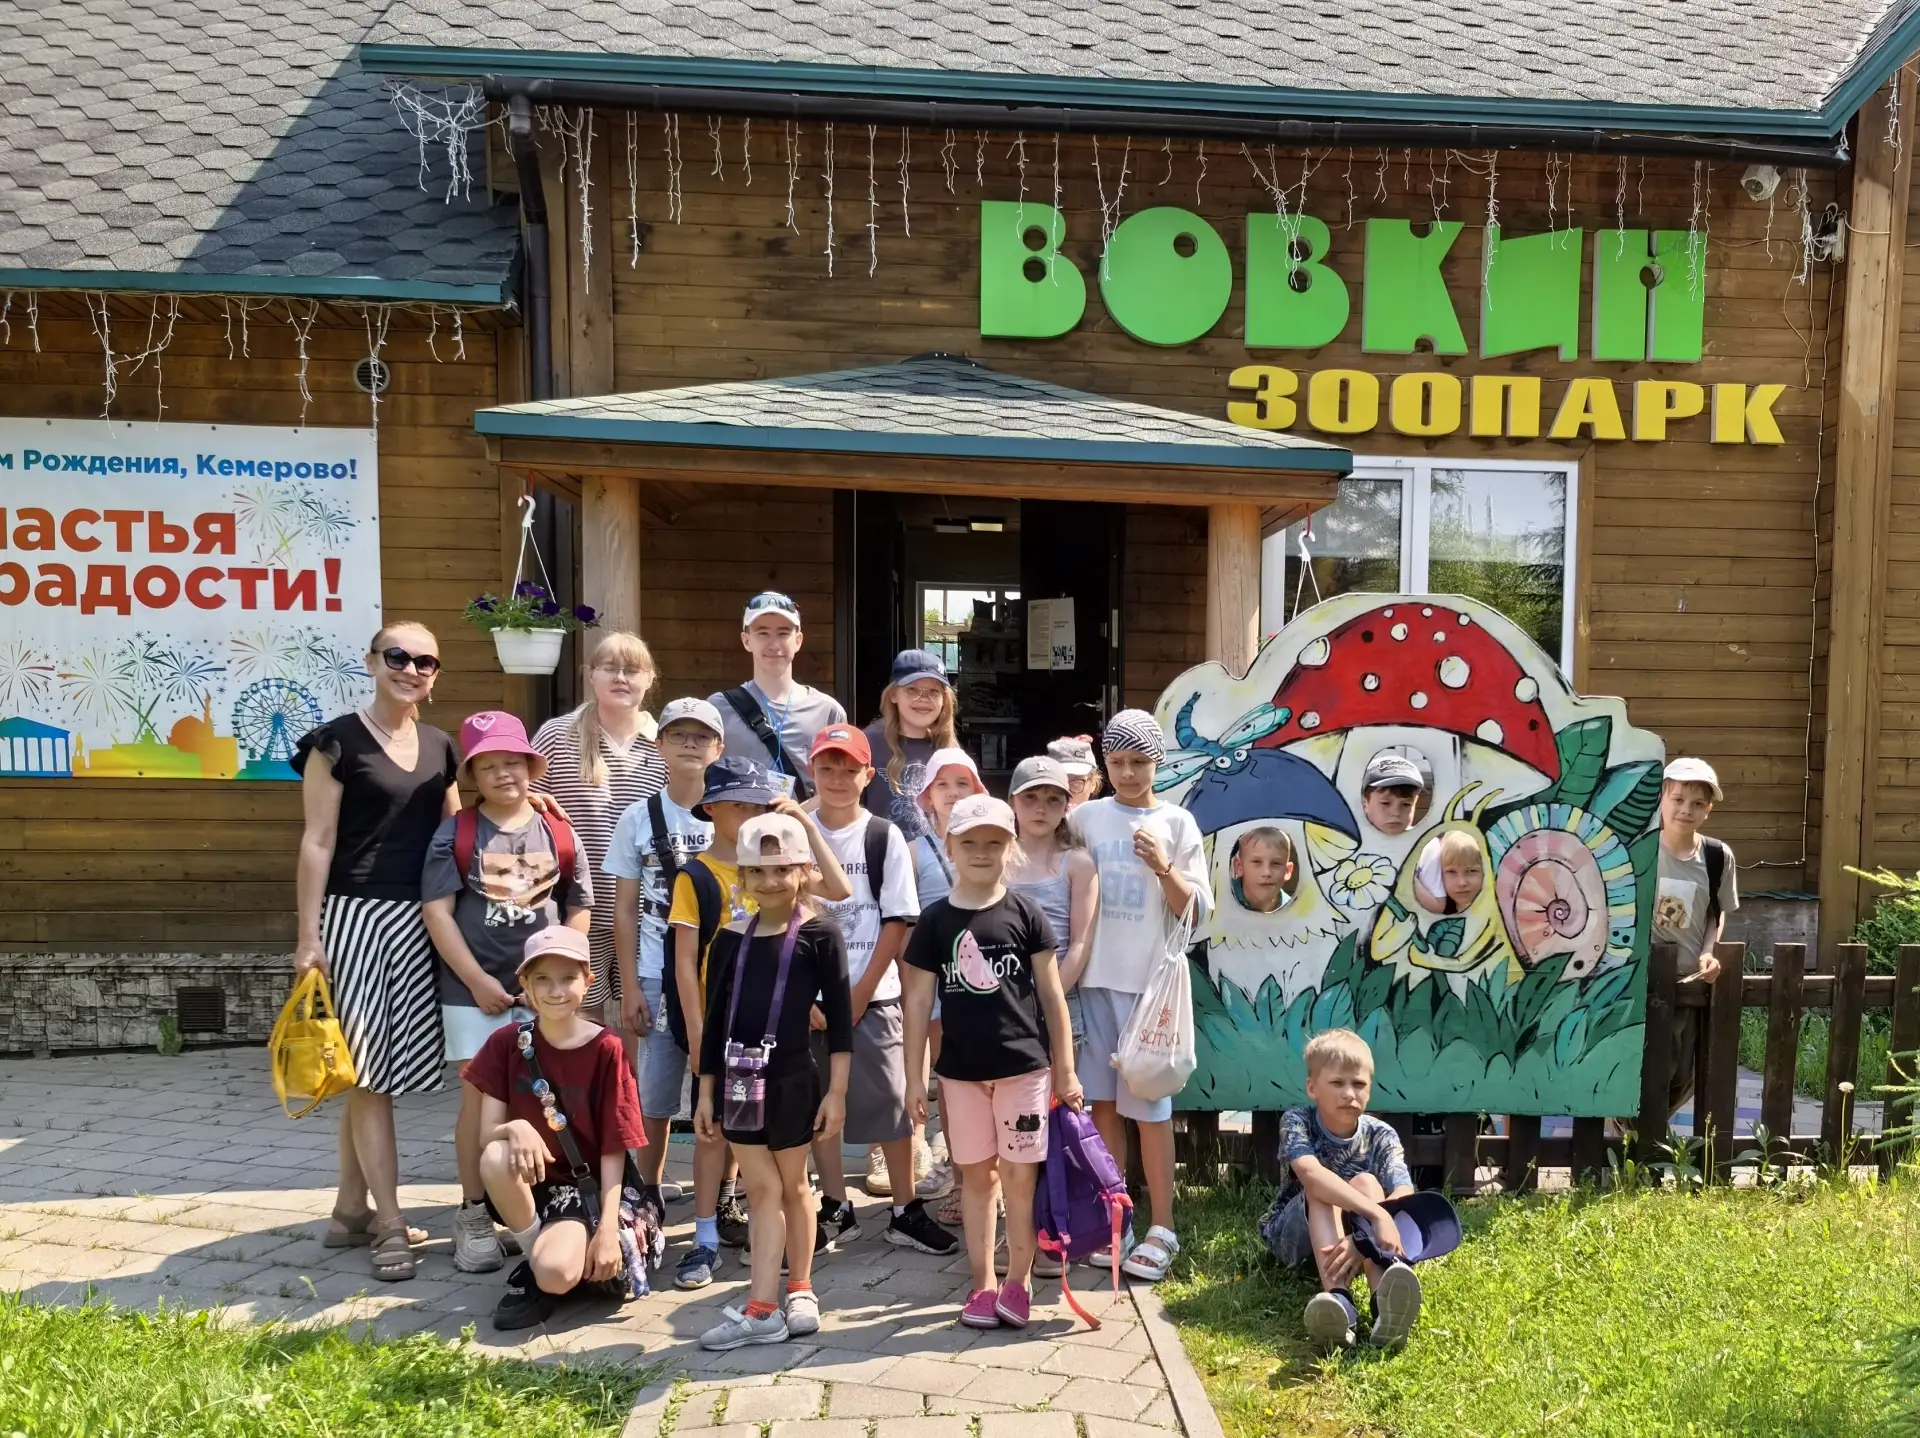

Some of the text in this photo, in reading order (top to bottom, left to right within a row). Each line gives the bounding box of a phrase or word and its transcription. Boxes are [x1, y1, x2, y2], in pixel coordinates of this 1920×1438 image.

[980, 201, 1706, 364] ВОВКИН
[1225, 365, 1786, 446] ЗООПАРК
[24, 450, 187, 478] Рождения,
[197, 454, 357, 482] Кемерово!
[0, 507, 236, 555] астья
